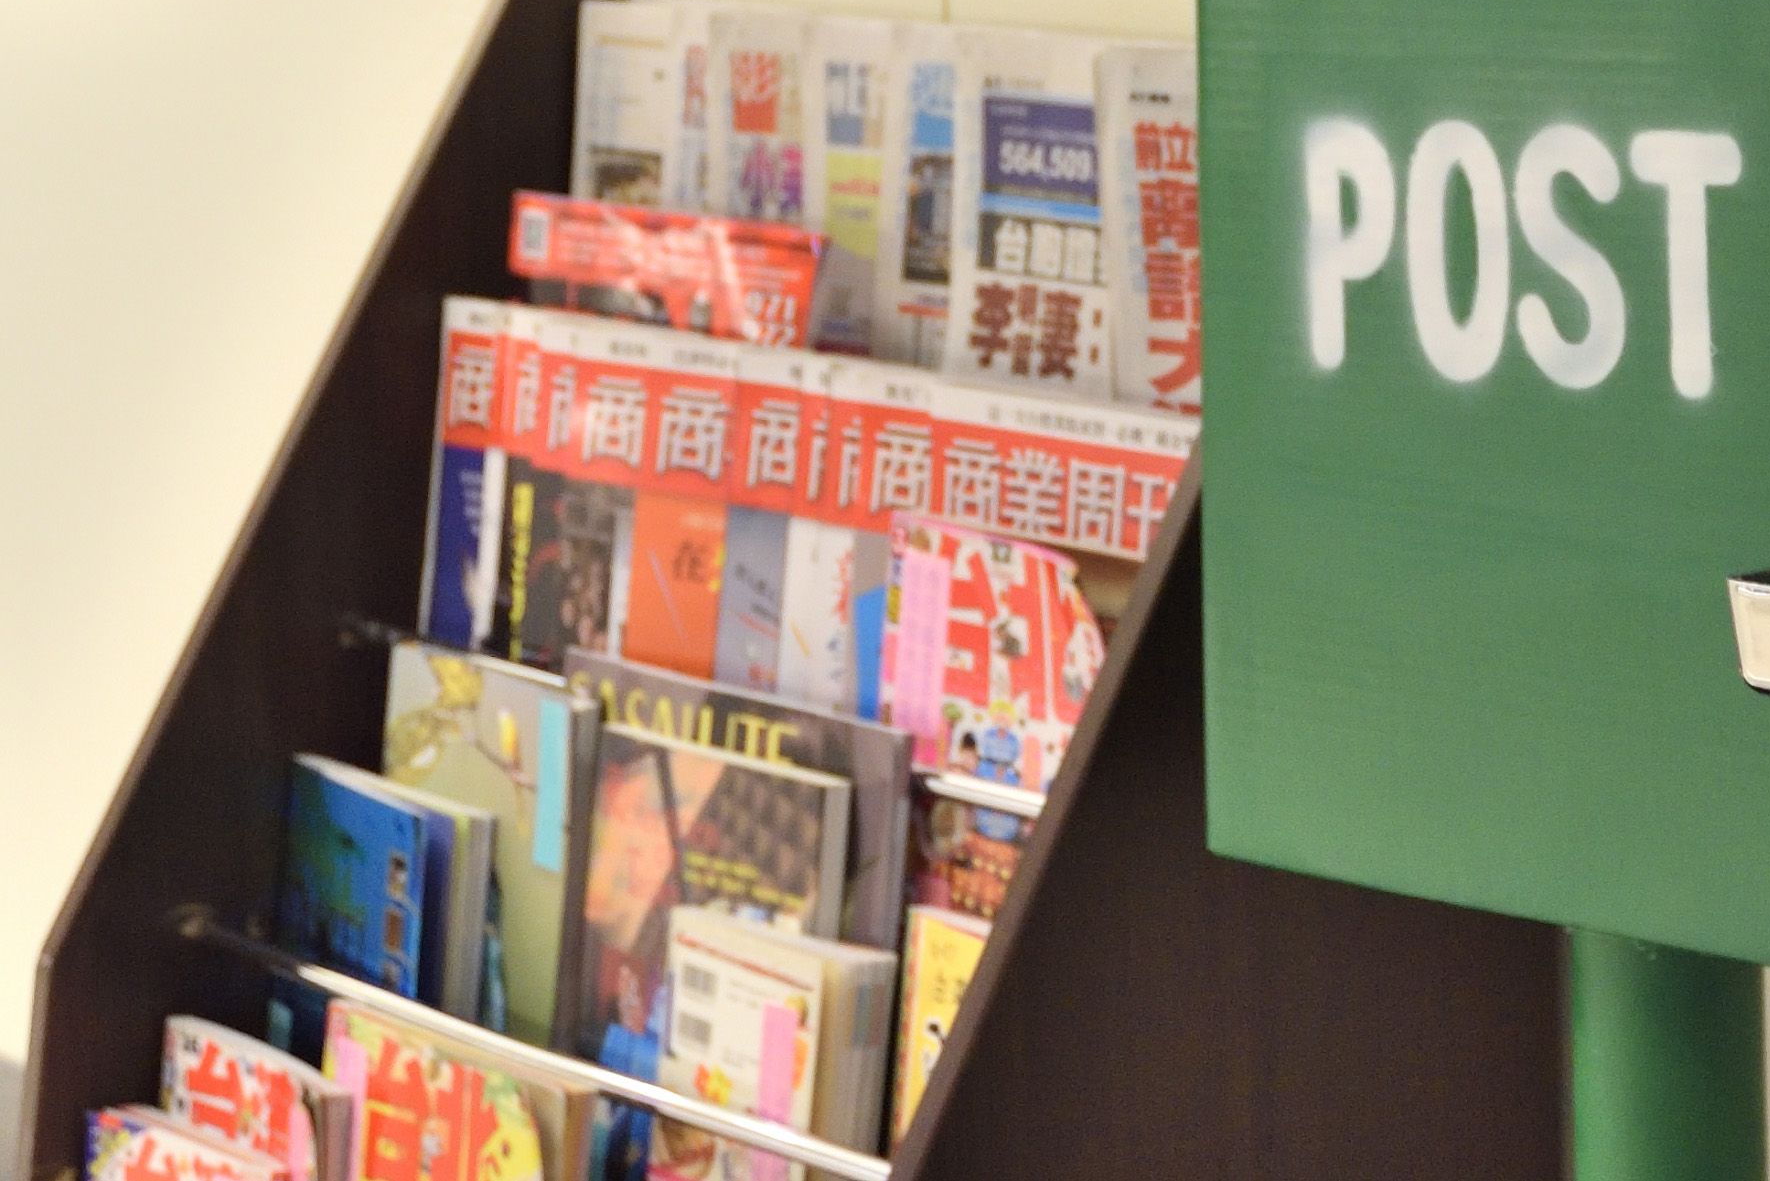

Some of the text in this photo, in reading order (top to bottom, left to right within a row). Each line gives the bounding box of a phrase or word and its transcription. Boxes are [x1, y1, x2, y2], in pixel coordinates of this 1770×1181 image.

[1304, 119, 1742, 400] POST
[581, 374, 648, 468] 商
[655, 385, 729, 480] 商
[942, 436, 1177, 553] 商業周刊
